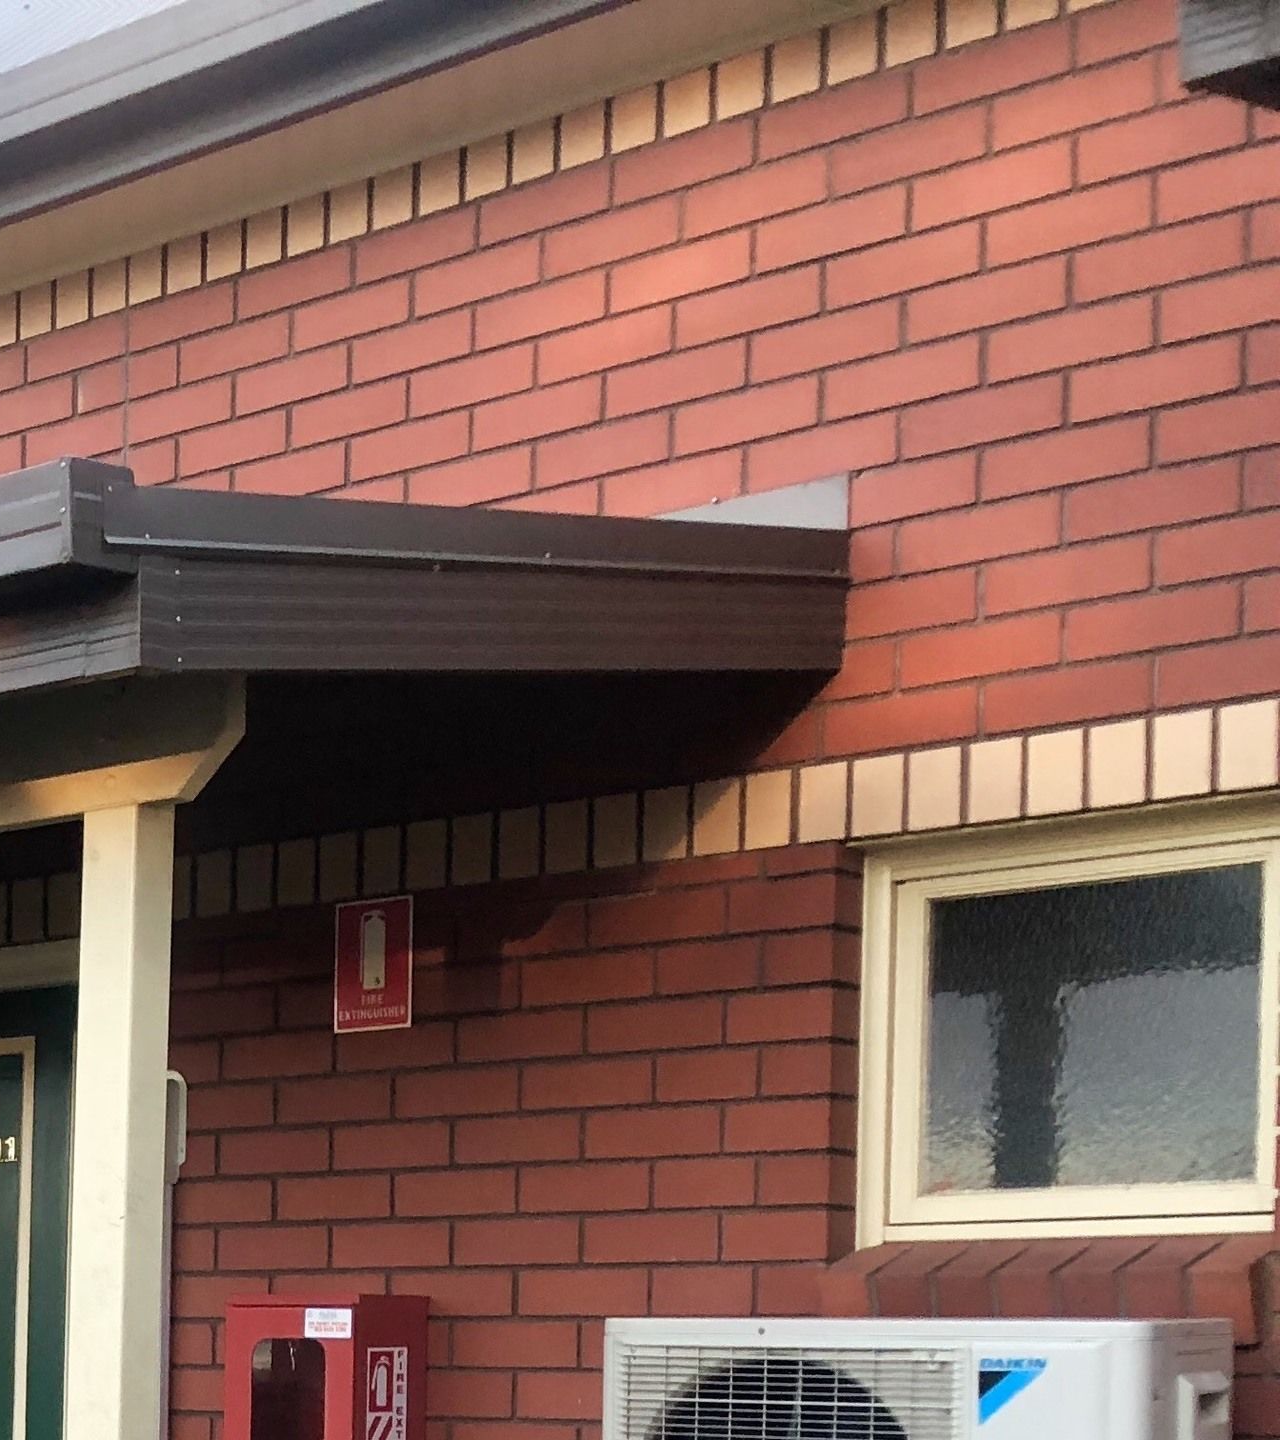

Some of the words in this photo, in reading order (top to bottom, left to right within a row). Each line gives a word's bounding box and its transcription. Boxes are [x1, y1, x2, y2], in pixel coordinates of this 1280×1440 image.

[361, 994, 384, 1006] FIRE
[338, 1005, 406, 1021] EXTINGUISHER
[978, 1357, 1048, 1370] DAIKIN
[396, 1350, 404, 1394] FIRE
